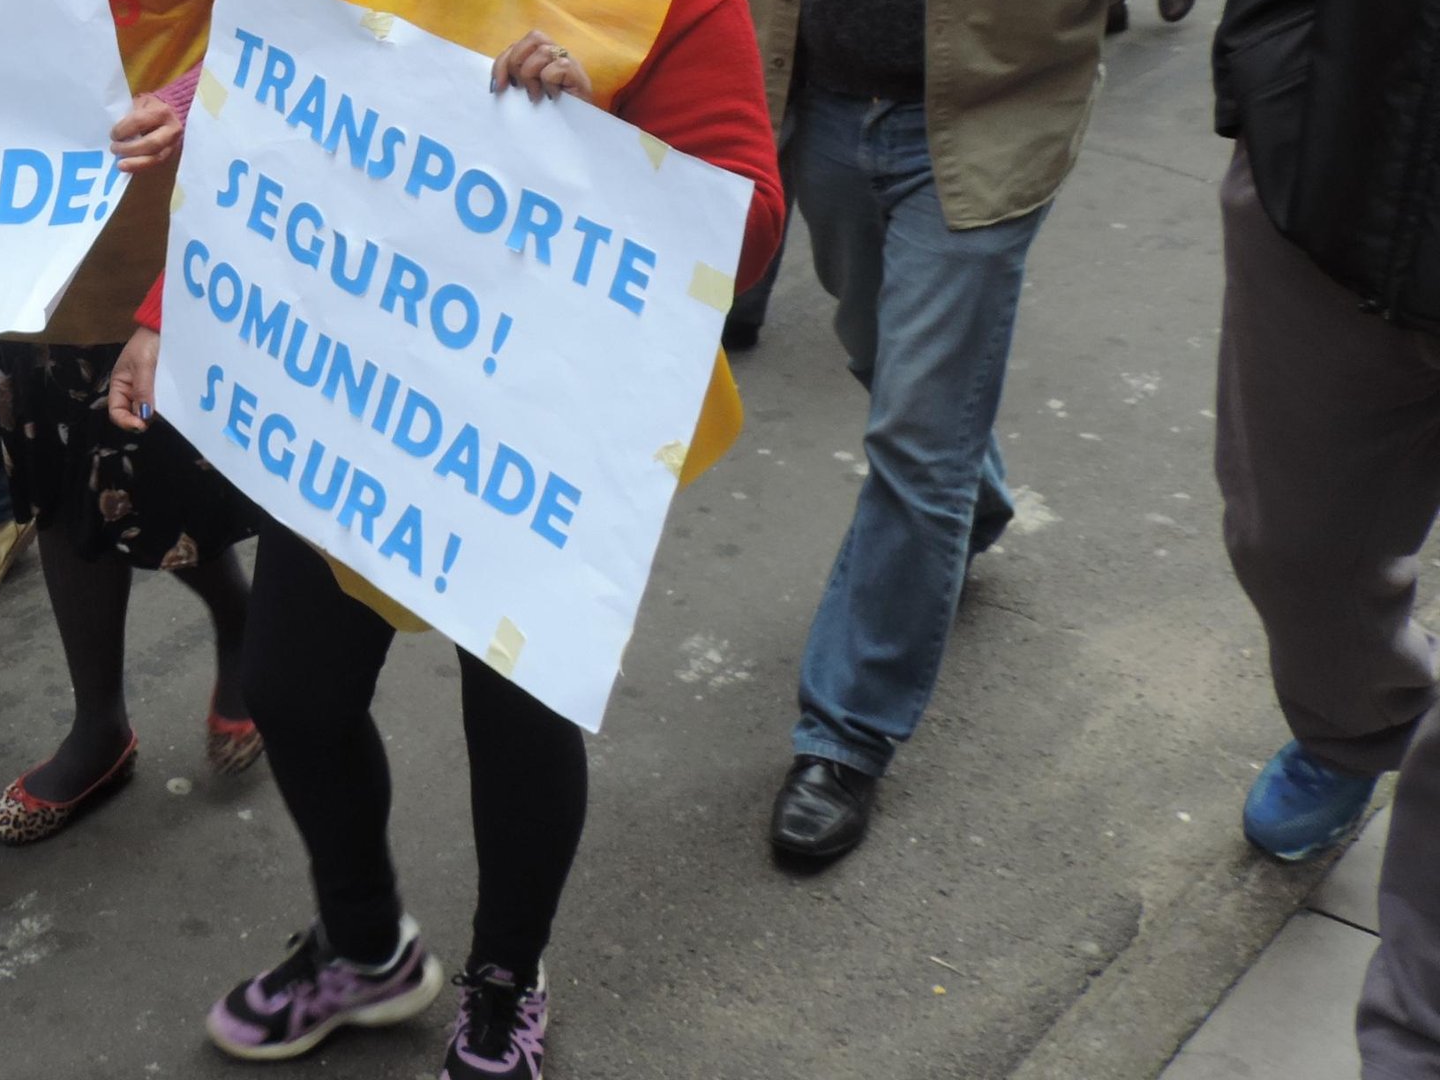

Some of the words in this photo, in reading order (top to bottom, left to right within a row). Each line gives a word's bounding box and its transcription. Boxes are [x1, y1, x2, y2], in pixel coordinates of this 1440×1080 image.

[216, 158, 514, 376] SEGURO!
[233, 27, 656, 316] TRANSPORTE
[182, 239, 582, 550] COMUNIDADE
[199, 364, 463, 594] SEGURA!
